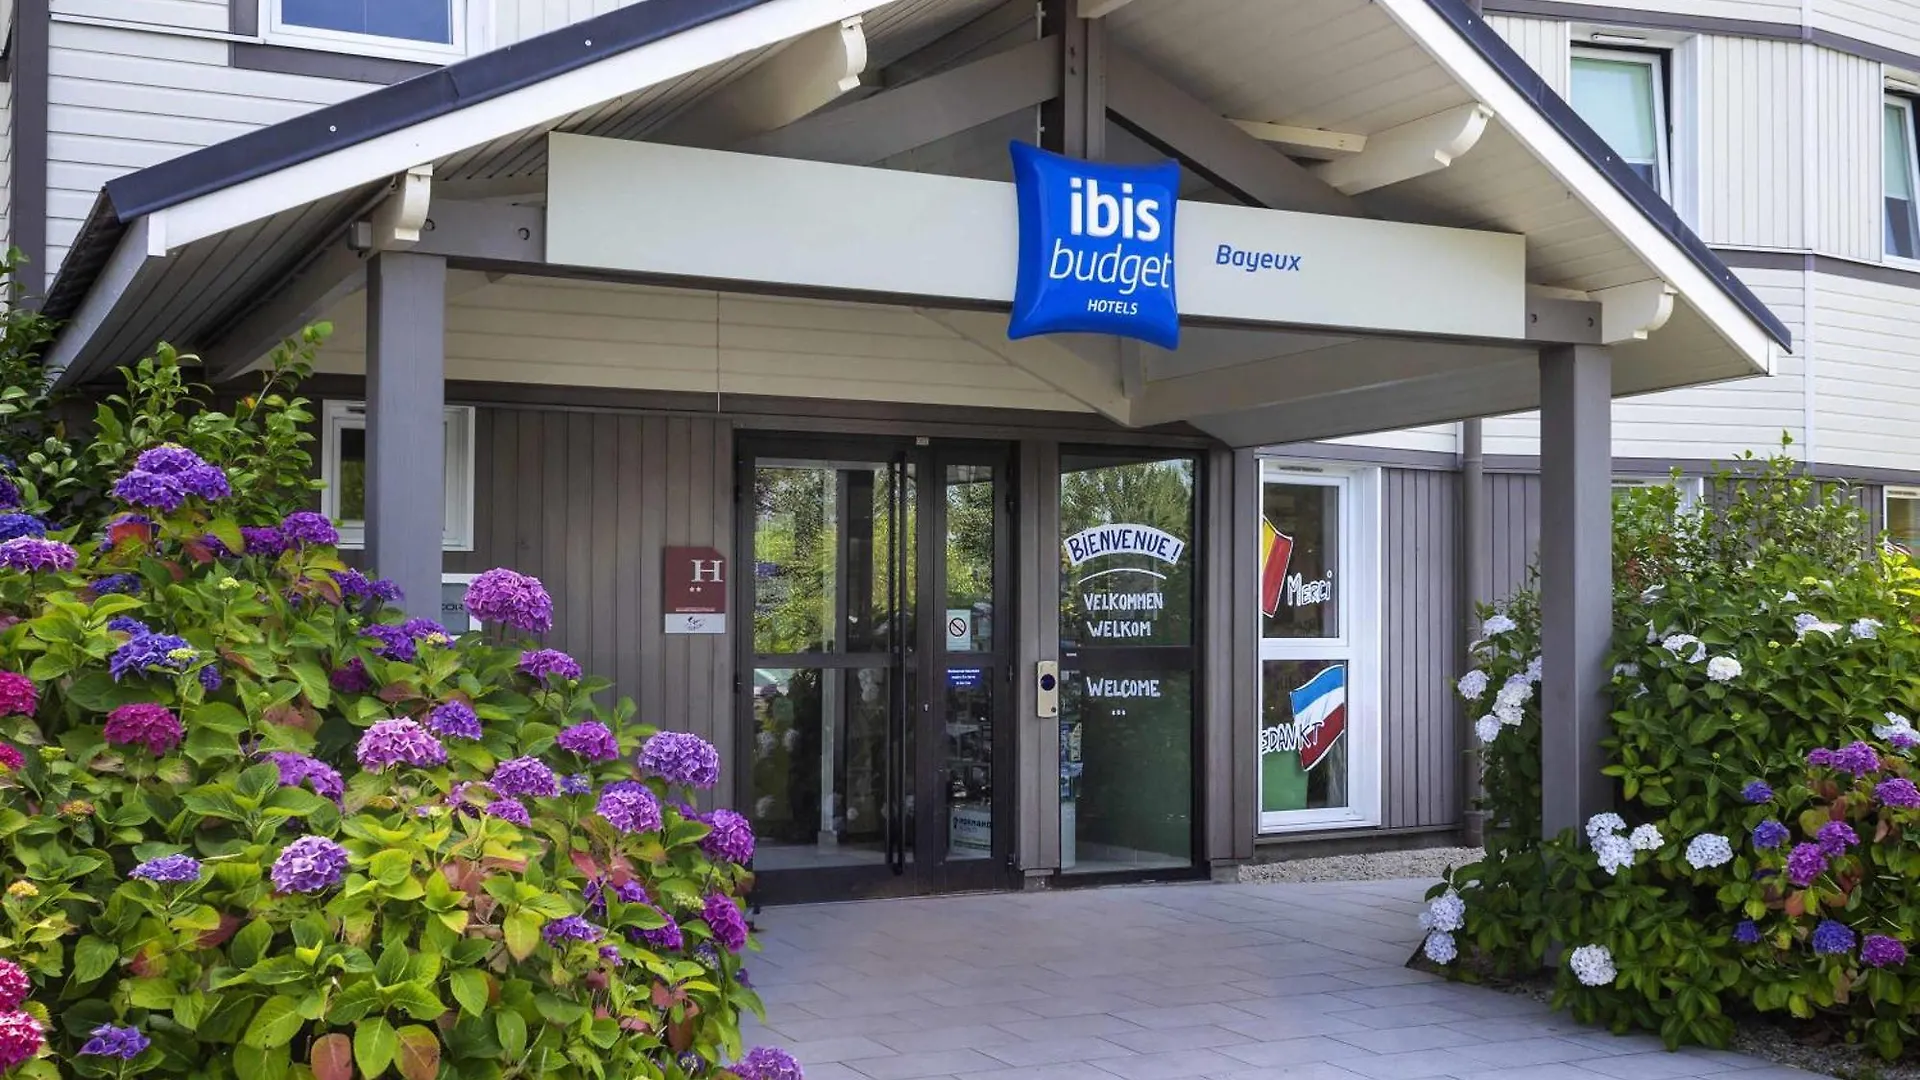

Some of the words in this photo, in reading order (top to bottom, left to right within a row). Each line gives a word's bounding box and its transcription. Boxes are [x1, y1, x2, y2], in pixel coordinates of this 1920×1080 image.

[1070, 177, 1161, 242] ibis
[1049, 238, 1173, 295] budget
[1216, 244, 1301, 272] Bayeux
[1087, 299, 1138, 315] HOTELS
[690, 559, 724, 582] H
[1083, 592, 1164, 611] VELKOMMEN
[1087, 620, 1151, 638] WELKOM
[1086, 676, 1161, 698] WELCOME
